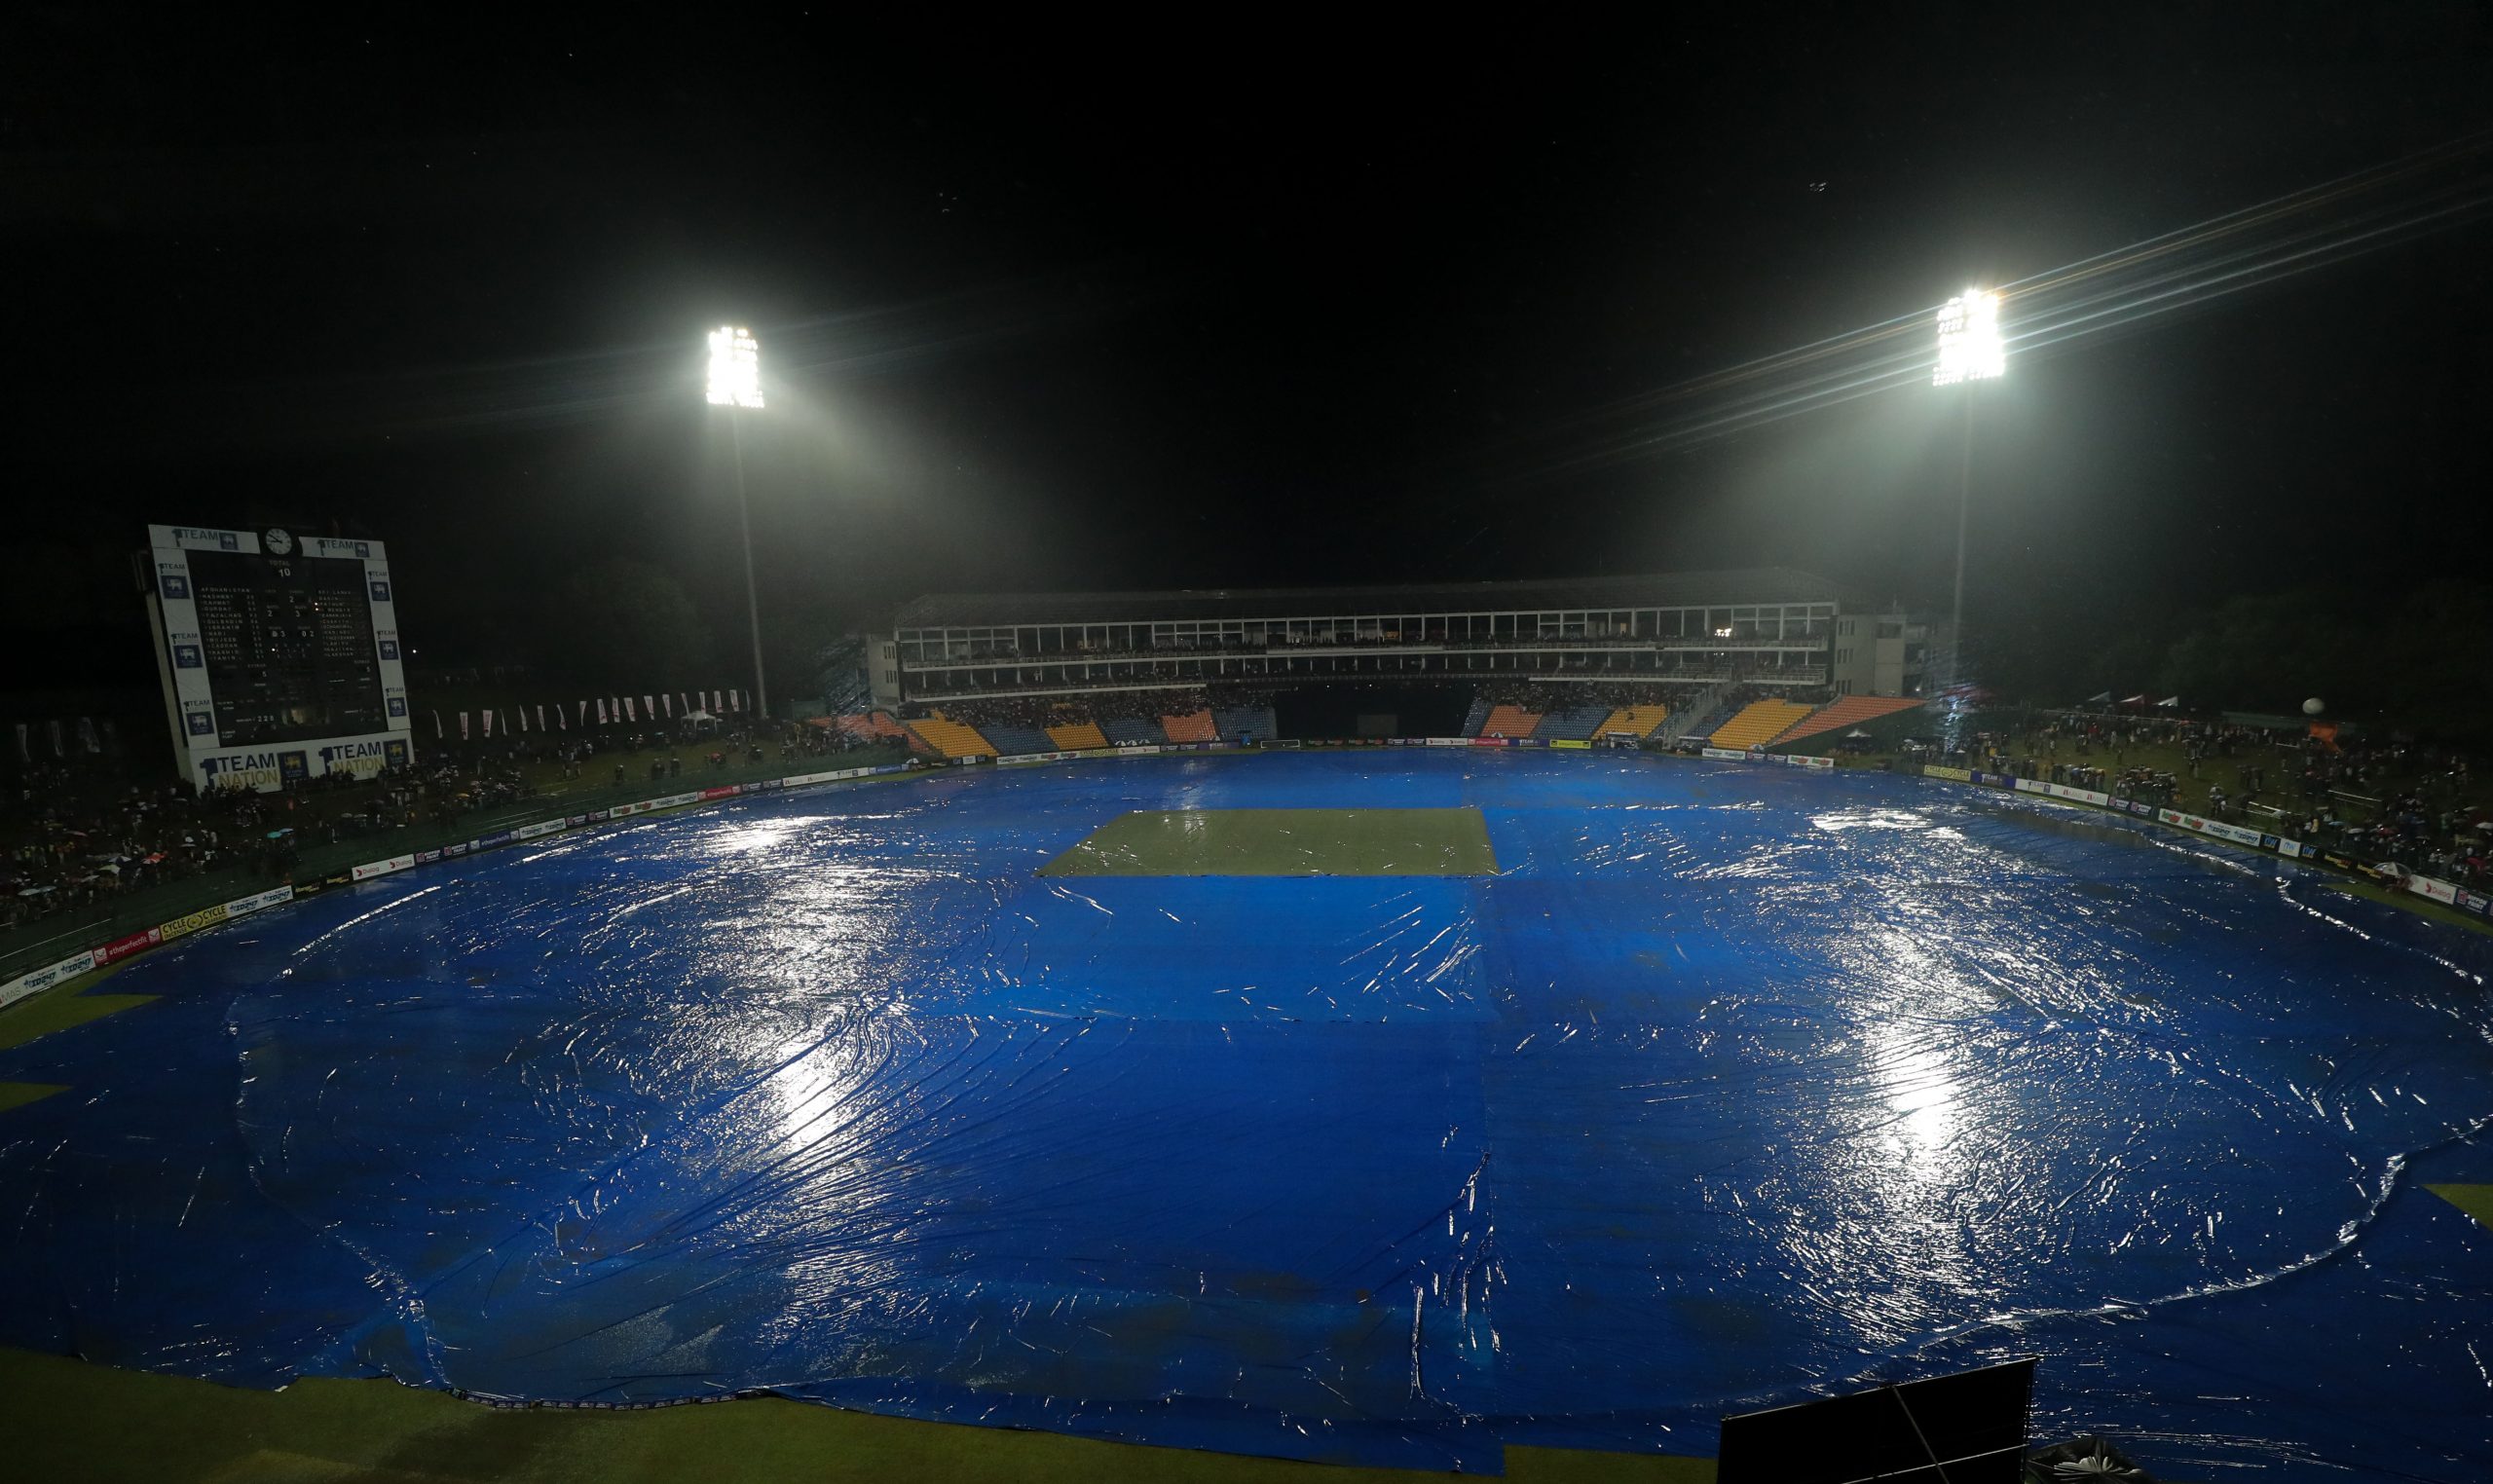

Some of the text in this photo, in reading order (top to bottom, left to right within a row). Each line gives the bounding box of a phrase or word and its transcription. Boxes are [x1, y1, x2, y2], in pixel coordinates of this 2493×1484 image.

[181, 529, 218, 541] TEAM
[323, 539, 353, 550] TEAM
[279, 568, 290, 576] 10
[334, 742, 382, 760] TEAM
[217, 753, 276, 772] TEAM
[334, 758, 385, 775] NATION
[218, 769, 279, 790] NATION
[362, 866, 380, 874] Dialog
[2432, 887, 2451, 900] Dialog
[203, 905, 226, 920] CYCLE
[163, 919, 187, 934] CYCLE
[108, 936, 149, 955] #theperfectfit
